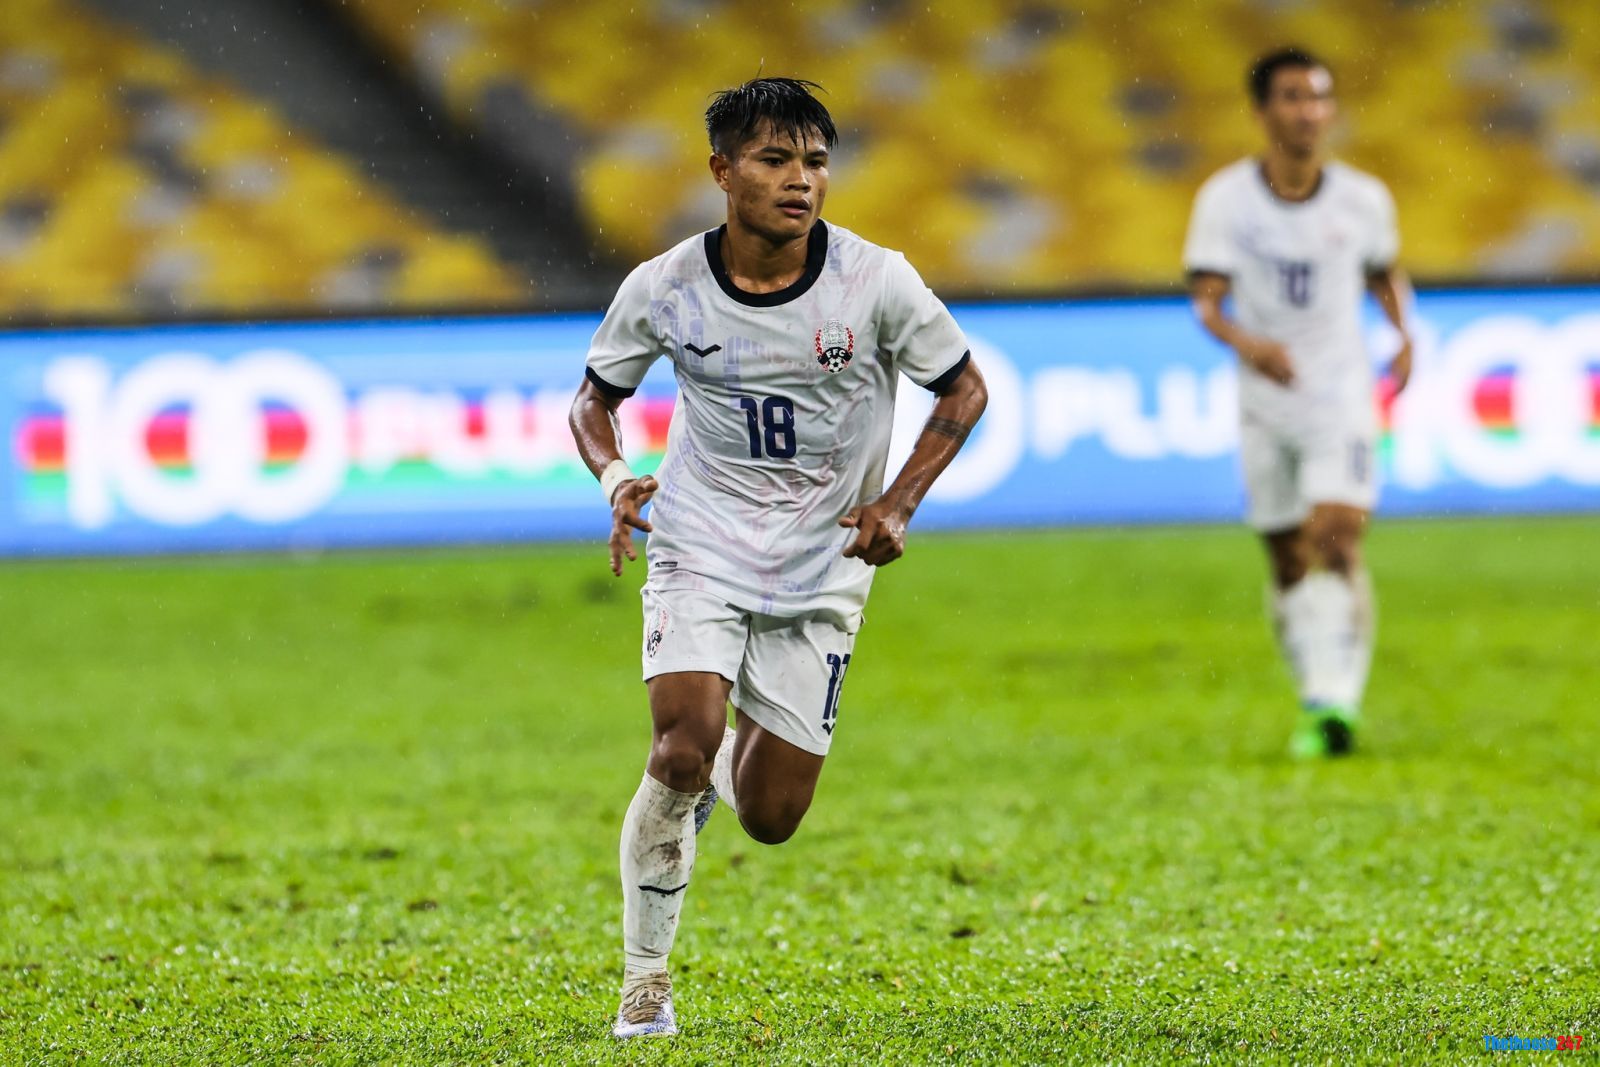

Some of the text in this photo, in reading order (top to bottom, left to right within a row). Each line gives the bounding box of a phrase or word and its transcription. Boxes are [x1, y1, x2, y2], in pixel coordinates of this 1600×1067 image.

[825, 348, 846, 358] FFC
[42, 352, 345, 528] 100
[740, 396, 797, 458] 18
[1030, 365, 1240, 462] PLU
